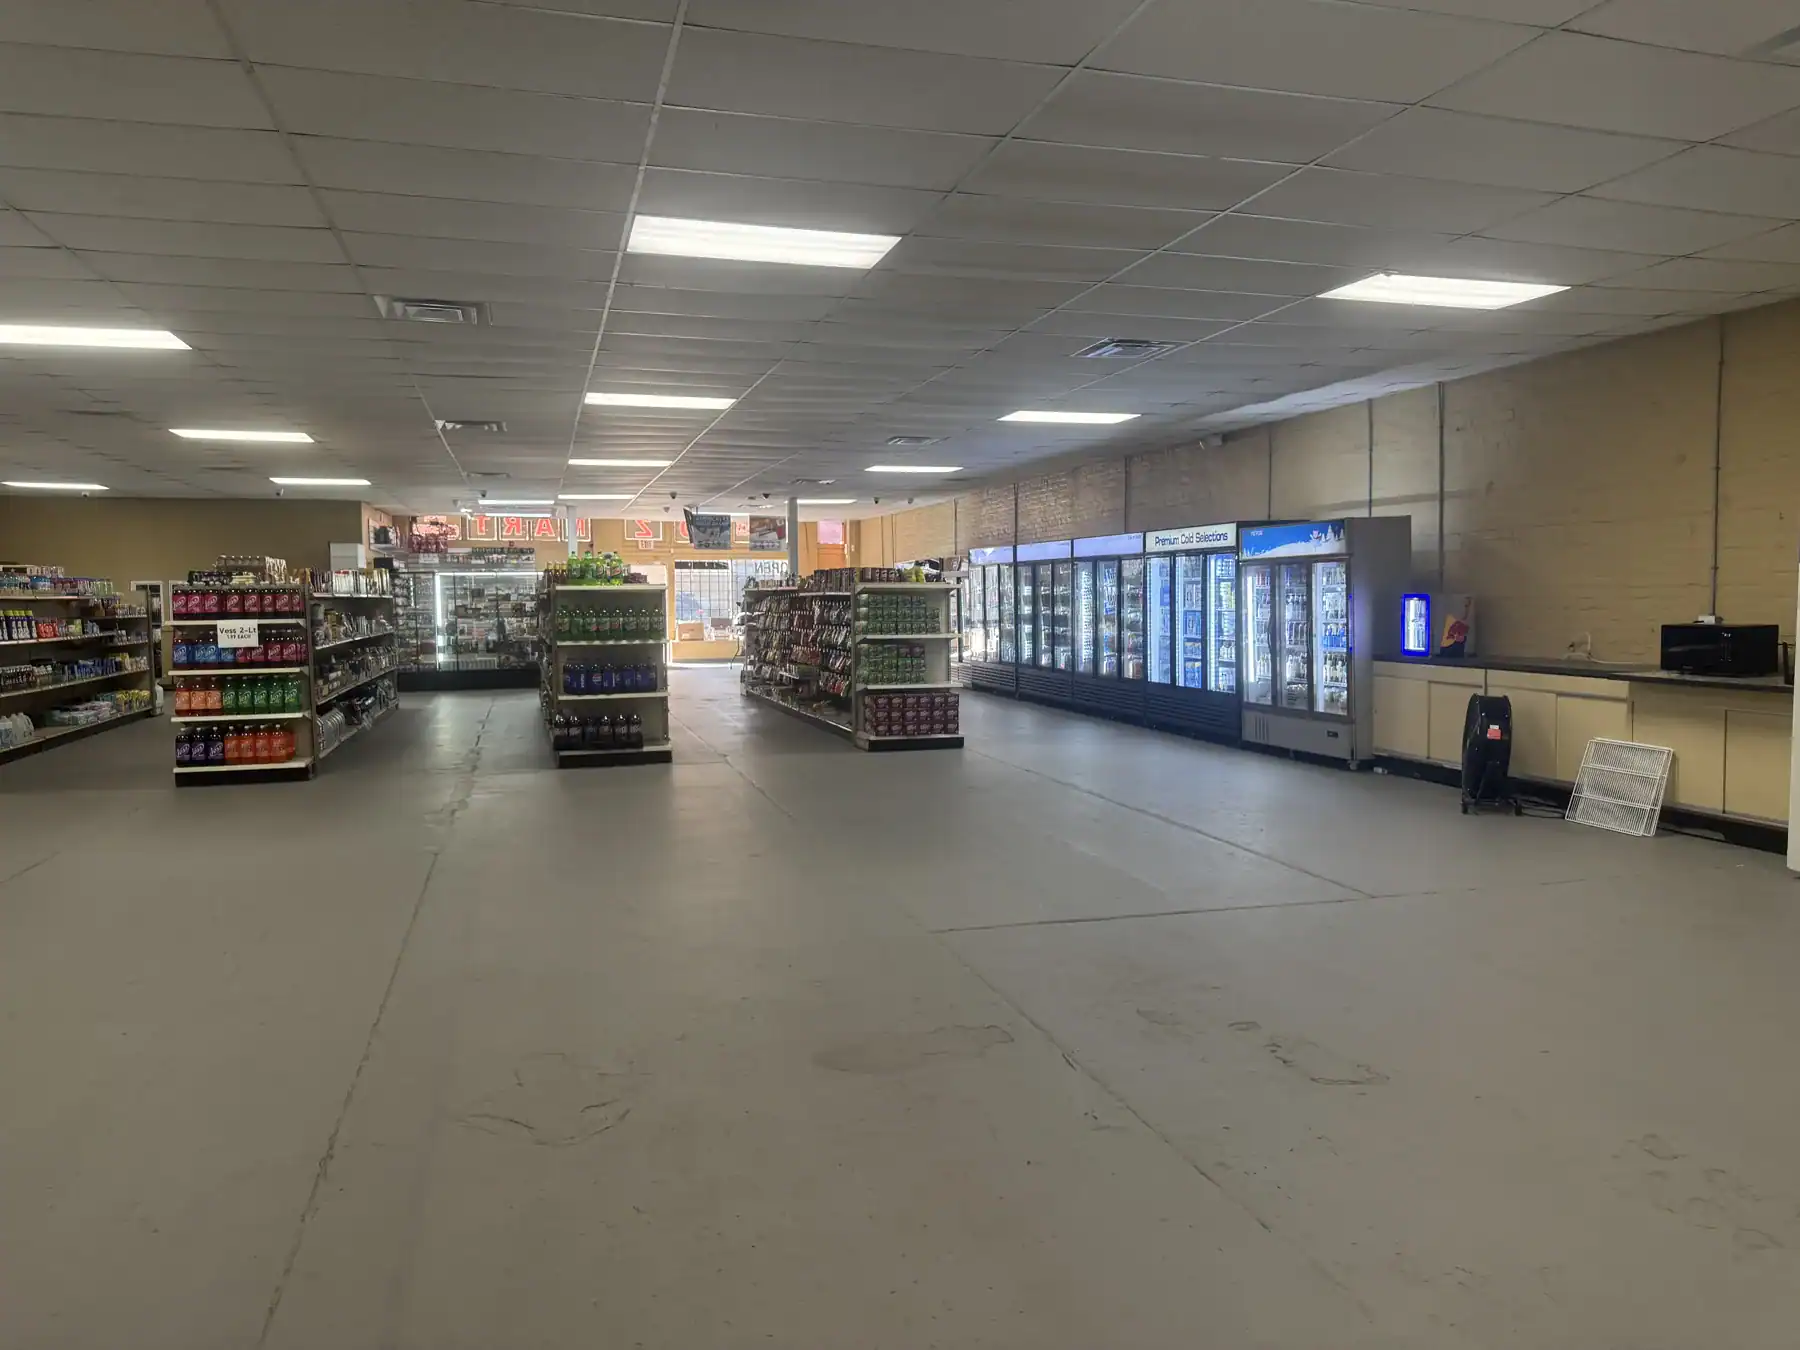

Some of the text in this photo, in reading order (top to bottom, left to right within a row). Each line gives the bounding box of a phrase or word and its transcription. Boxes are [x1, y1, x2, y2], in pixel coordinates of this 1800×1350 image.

[1154, 536, 1180, 546] Premium
[1180, 533, 1194, 545] Cold
[1195, 531, 1229, 544] Selections
[239, 626, 257, 634] 2-Lt
